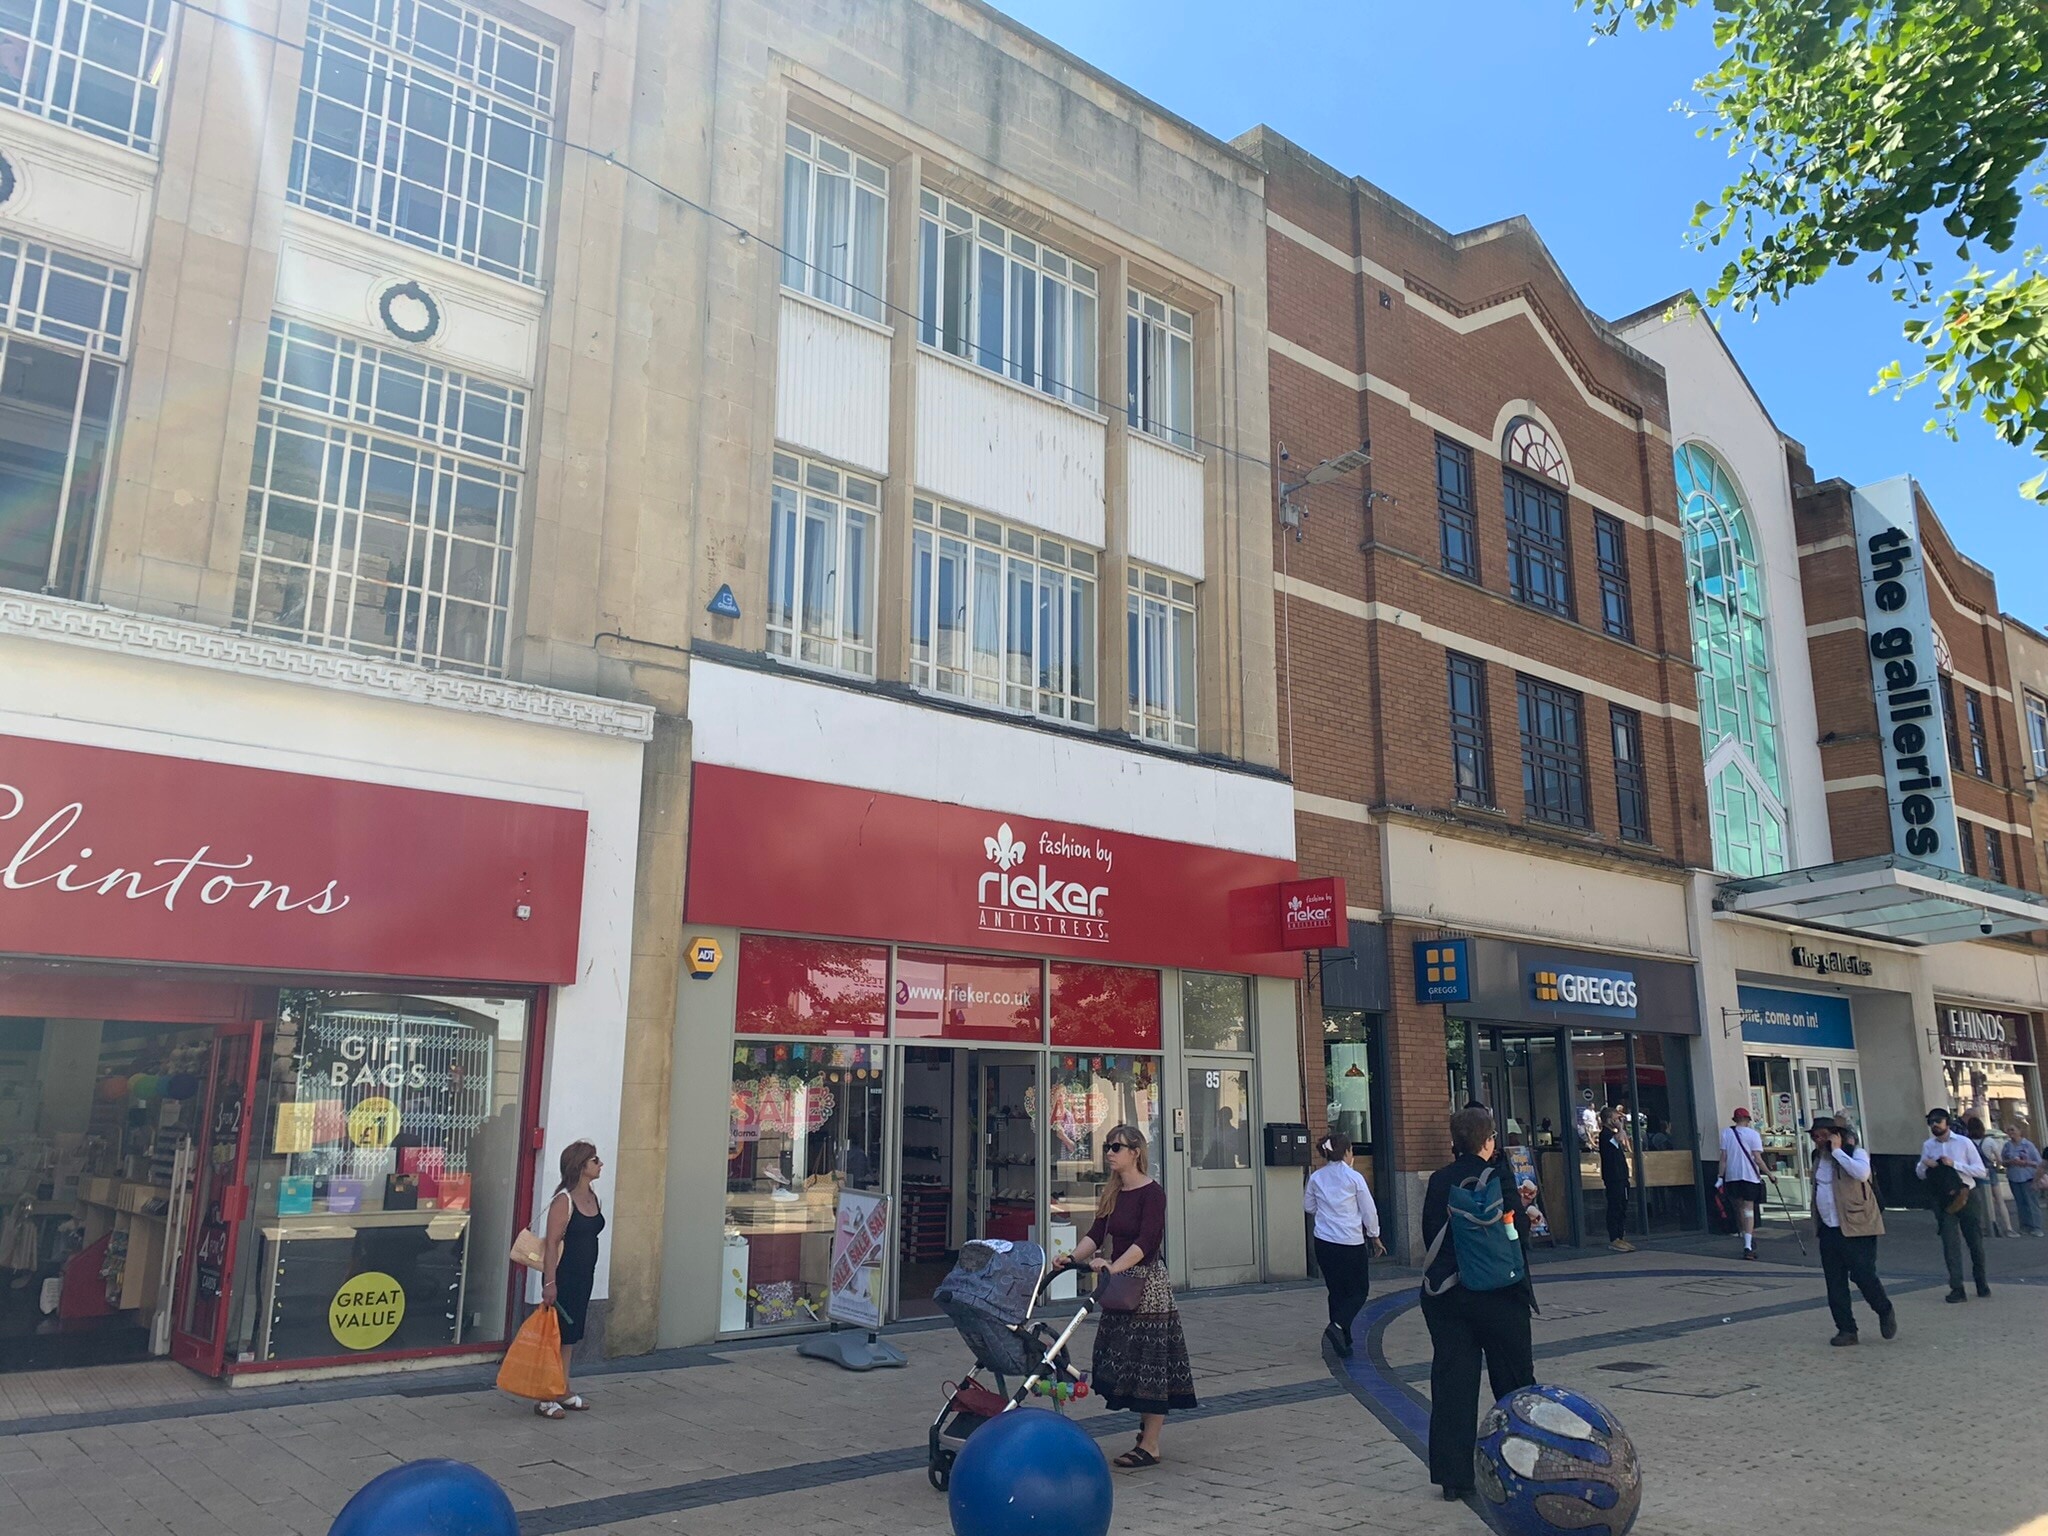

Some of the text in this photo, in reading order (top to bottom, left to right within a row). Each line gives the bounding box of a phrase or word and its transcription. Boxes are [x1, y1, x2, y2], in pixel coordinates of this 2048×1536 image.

[1869, 527, 1943, 856] the galleries
[1039, 831, 1112, 873] fashion by
[978, 864, 1109, 917] rieker
[979, 909, 1105, 939] ANTISTRESS
[1287, 906, 1331, 922] rieker
[698, 950, 715, 960] ADT
[1792, 946, 1873, 976] the galleries
[908, 985, 1031, 1006] www.rieker.co.uk
[1428, 986, 1457, 995] GREGGS
[1559, 974, 1638, 1009] GREGGS
[1765, 1010, 1791, 1026] come
[1792, 1013, 1806, 1027] on
[1806, 1011, 1819, 1028] in!
[340, 1035, 423, 1061] GIFT
[331, 1061, 426, 1089] BAGS
[1206, 1071, 1220, 1088] 85
[231, 1101, 241, 1132] 2
[731, 1087, 822, 1126] SALE
[1050, 1093, 1099, 1125] ALE
[199, 1231, 210, 1262] 4
[849, 1231, 872, 1263] SALE
[336, 1290, 400, 1307] GREAT
[335, 1310, 396, 1329] VALUE
